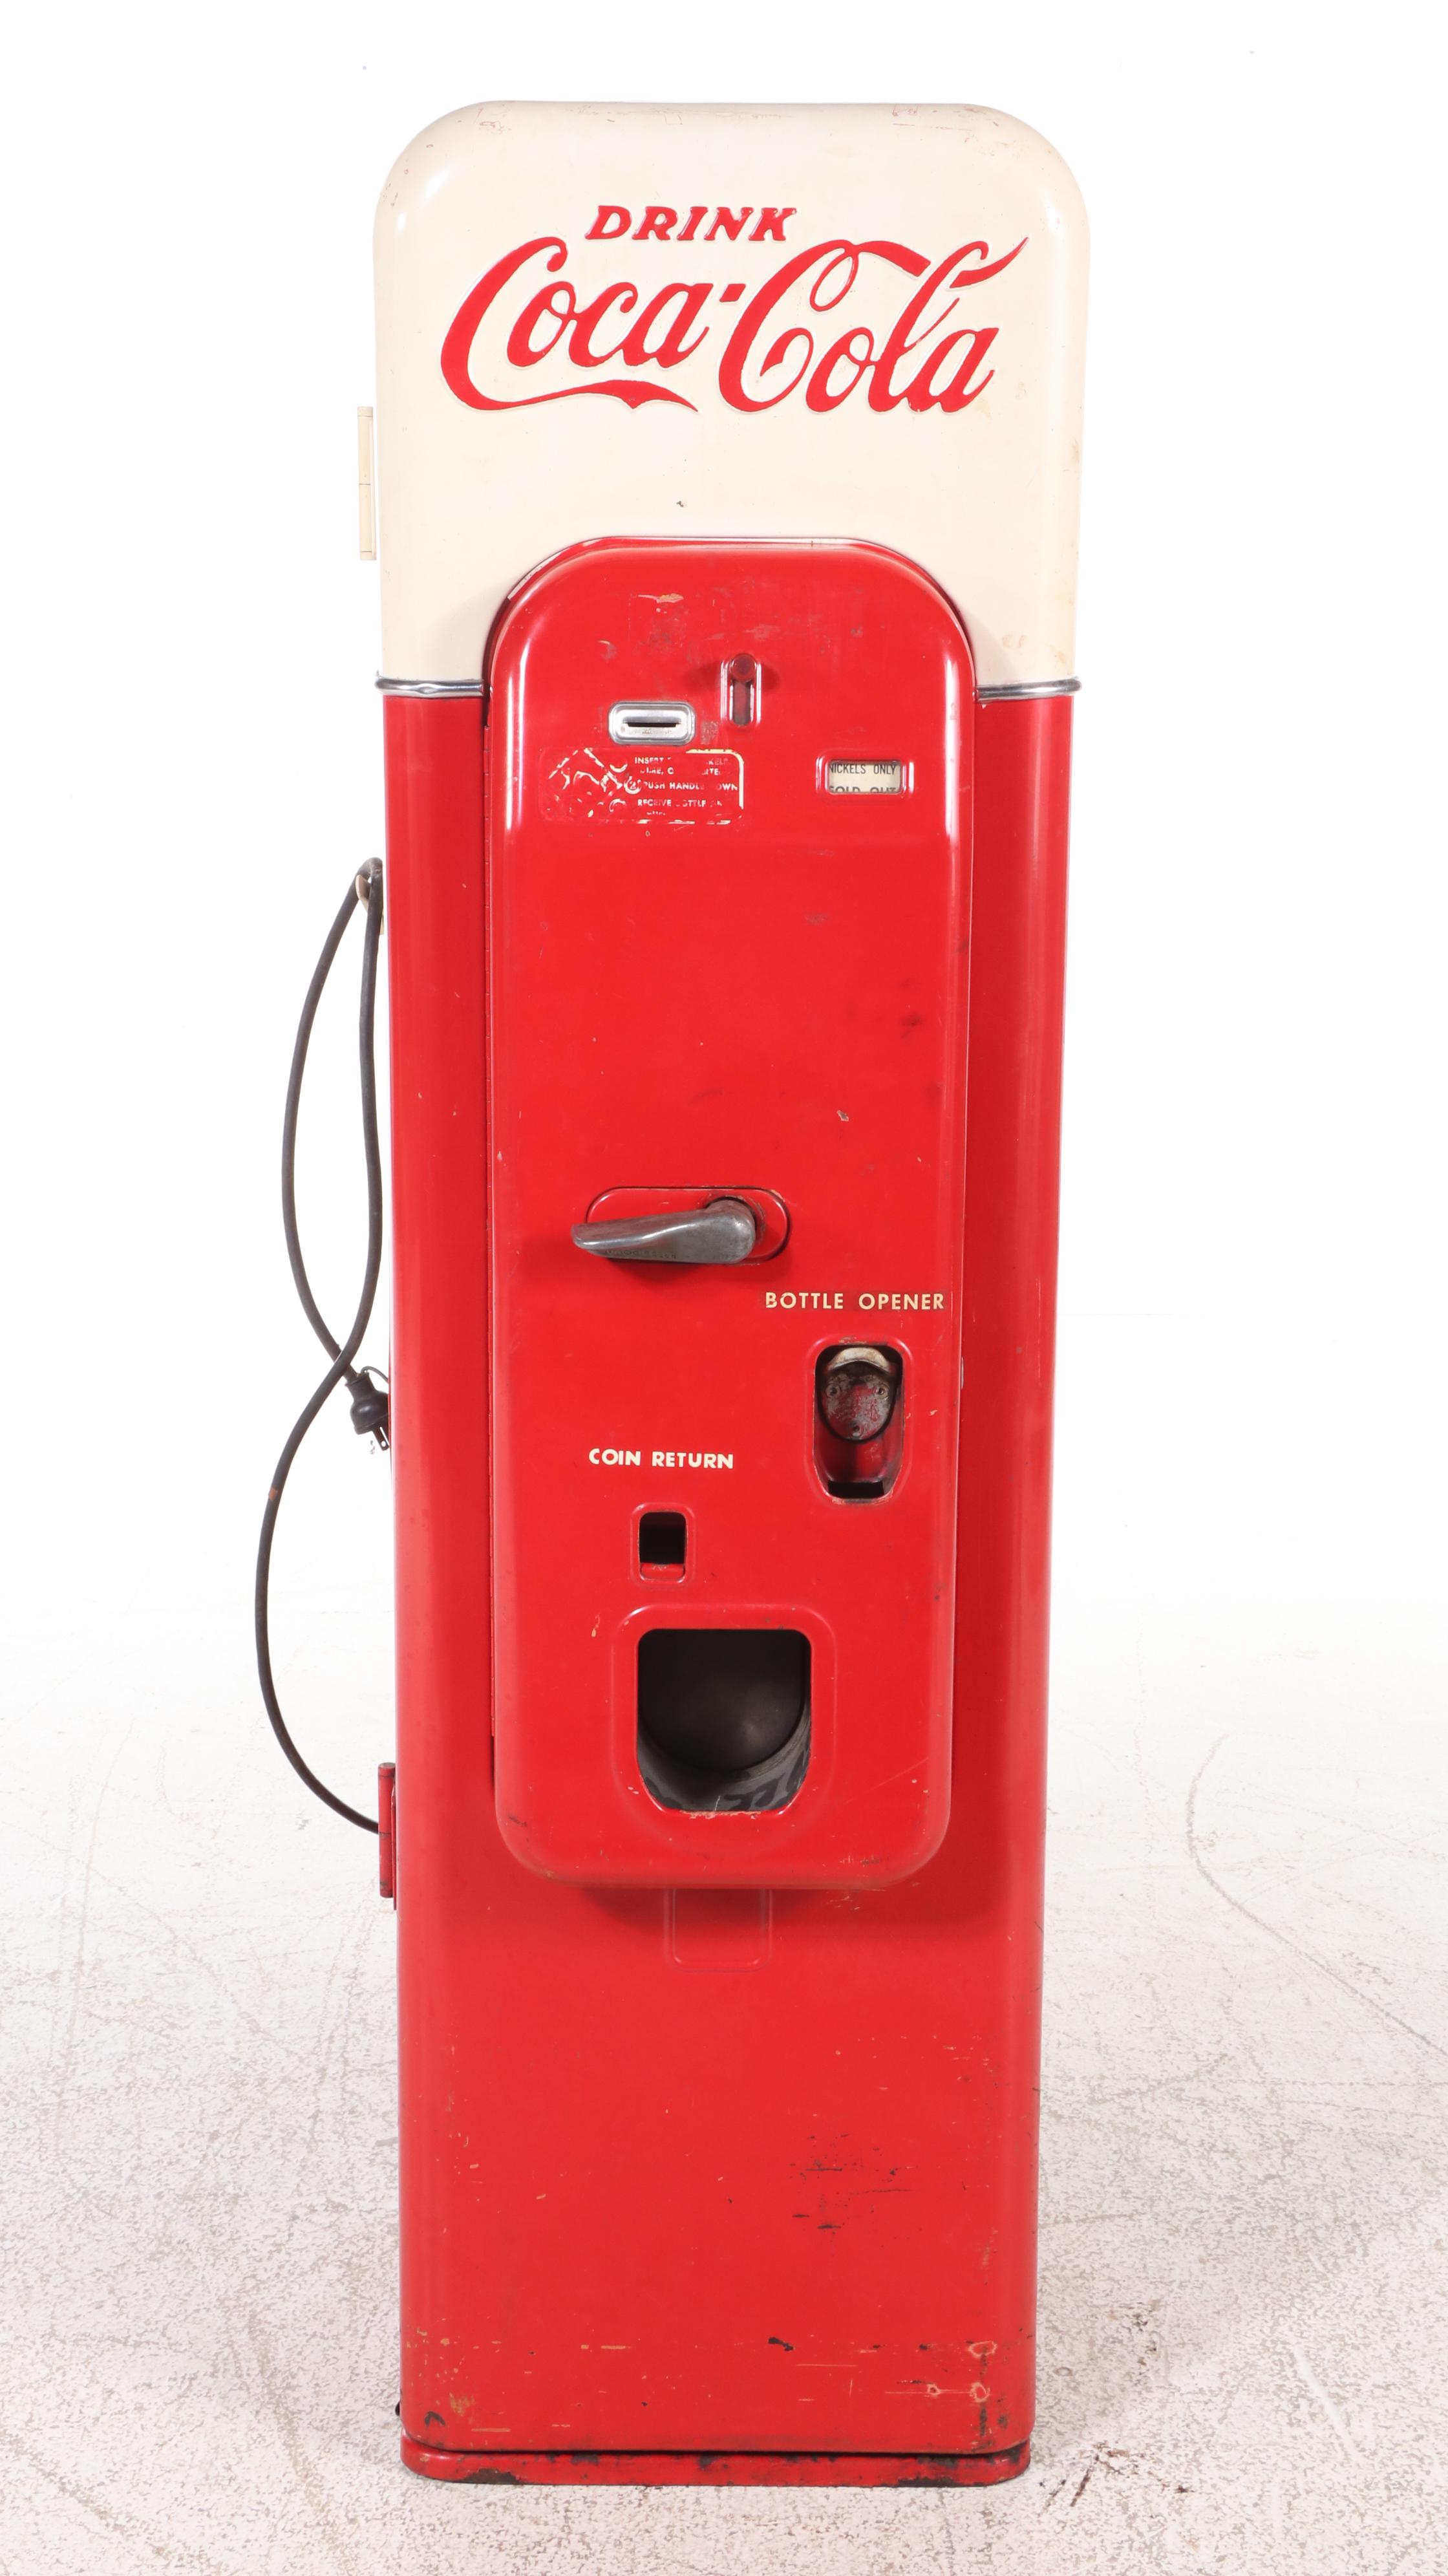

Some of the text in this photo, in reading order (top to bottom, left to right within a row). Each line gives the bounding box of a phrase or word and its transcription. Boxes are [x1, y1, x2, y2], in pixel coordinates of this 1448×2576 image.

[584, 205, 797, 241] DRINK
[440, 237, 1025, 413] Coca-Cola
[873, 764, 897, 775] ONLY
[669, 782, 705, 790] HANDL
[765, 1292, 944, 1311] BOTTLE OPENER
[588, 1448, 734, 1469] COIN RETURN
